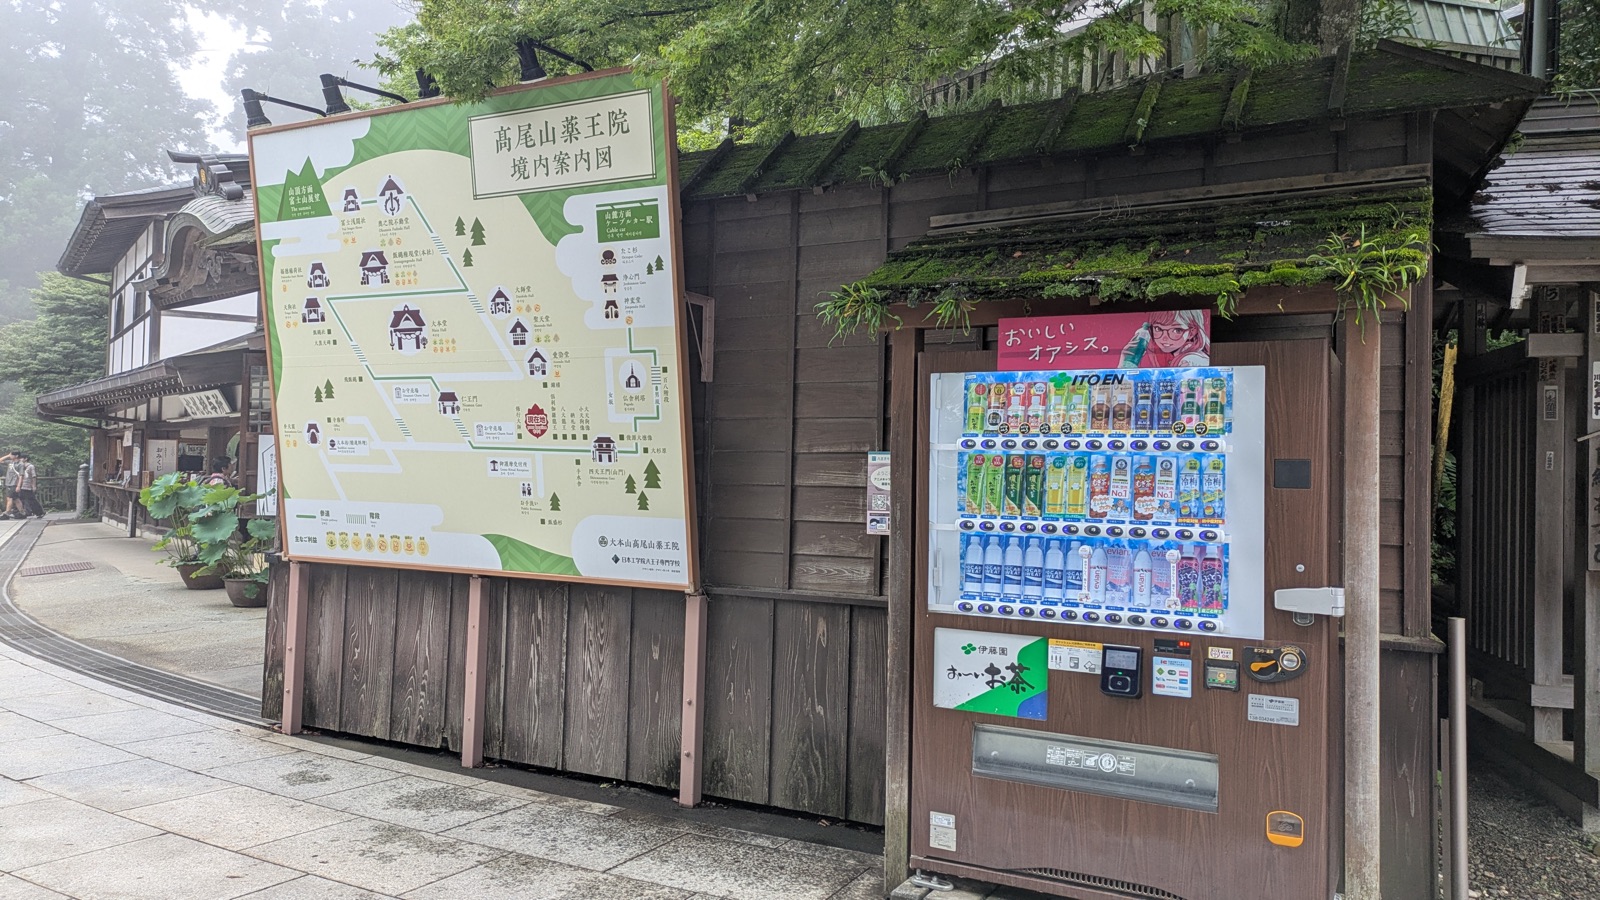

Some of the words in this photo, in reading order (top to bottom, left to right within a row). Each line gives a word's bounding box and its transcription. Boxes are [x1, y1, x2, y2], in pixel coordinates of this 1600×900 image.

[511, 145, 612, 181] 境内案内図
[288, 185, 313, 196] 山頂方面
[604, 210, 632, 220] 山麓方面
[605, 215, 654, 226] ケーブルカー駅
[515, 285, 532, 293] 大師堂
[431, 319, 448, 327] 大本堂
[1005, 322, 1075, 347] おいしい
[1028, 336, 1110, 364] オアシス。
[1071, 374, 1100, 386] ITO
[1101, 373, 1125, 385] EN
[461, 395, 478, 403] 仁王門
[527, 416, 546, 424] 現在地
[1111, 489, 1127, 497] No.1
[1157, 490, 1173, 498] No.1
[294, 535, 318, 544] 主なご利益
[1106, 548, 1129, 556] evian
[978, 645, 1008, 656] 伊藤園
